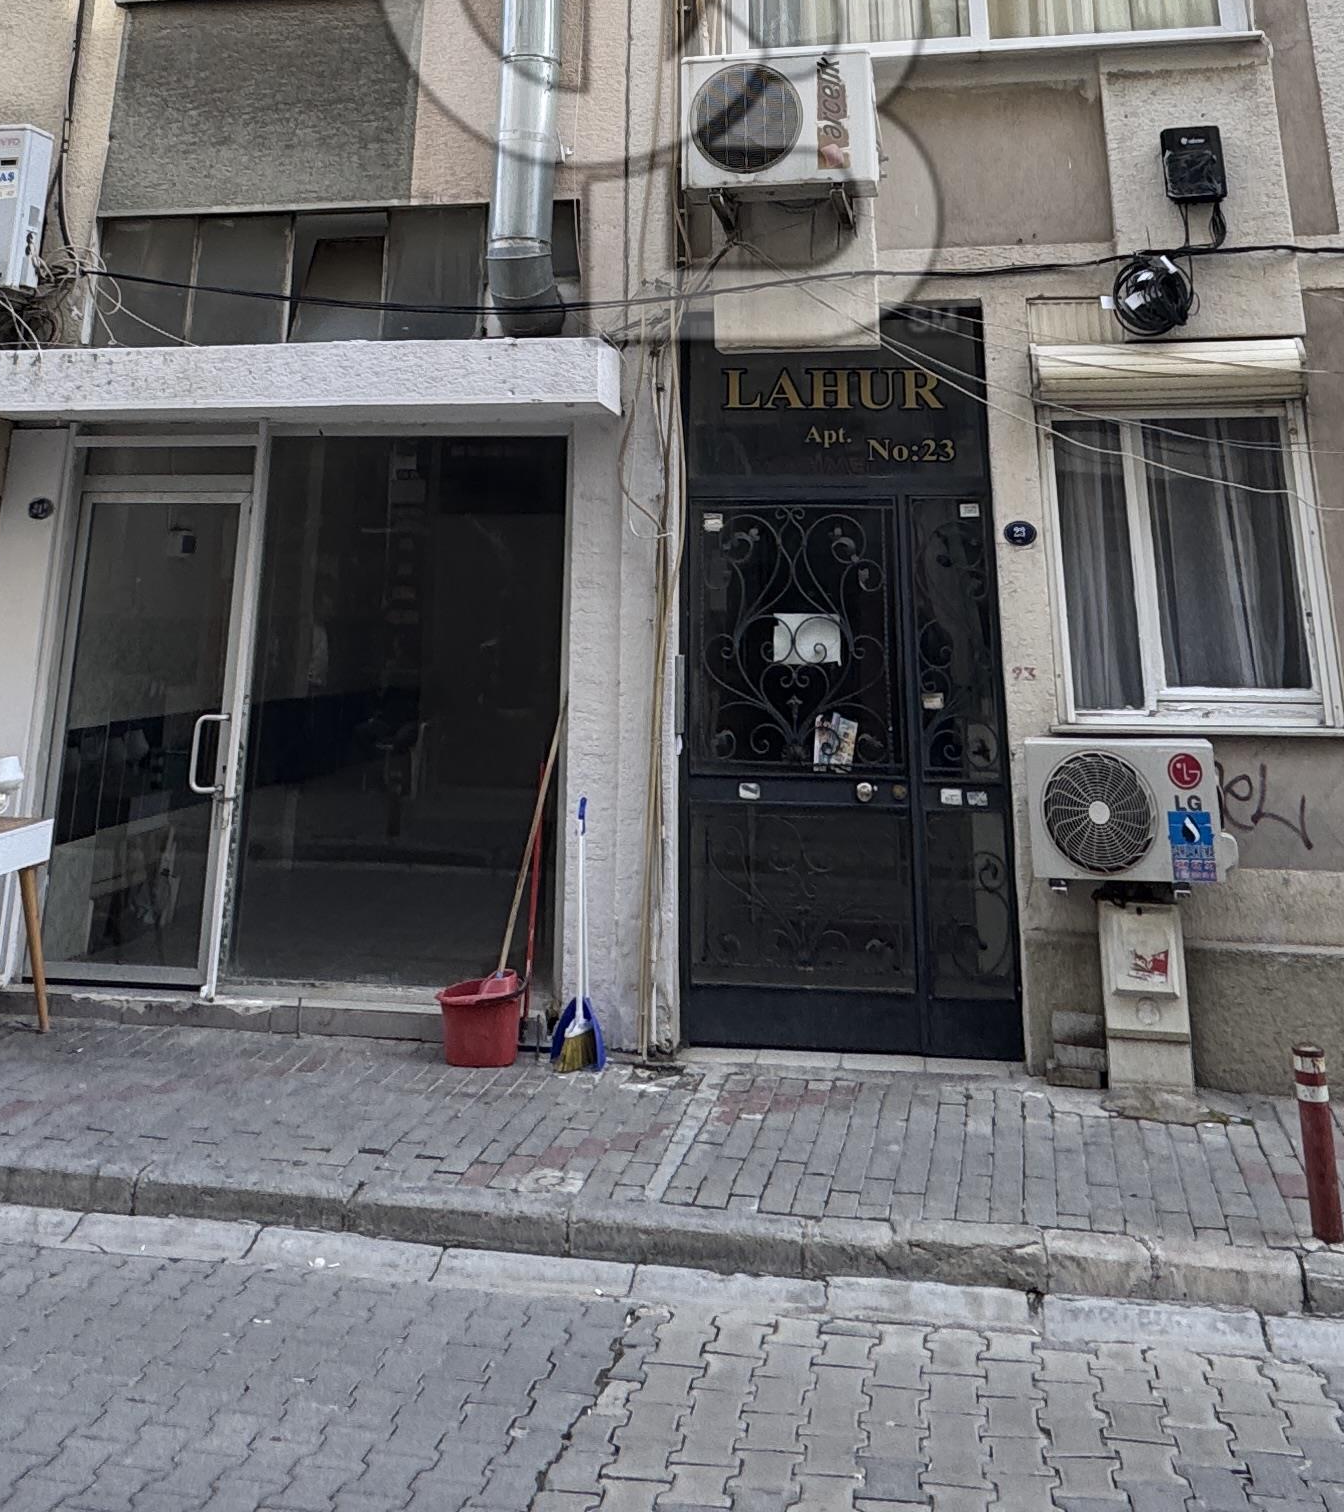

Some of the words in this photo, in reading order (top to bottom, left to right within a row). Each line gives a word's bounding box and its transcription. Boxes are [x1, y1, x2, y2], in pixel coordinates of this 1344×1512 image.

[722, 368, 945, 411] LAHUR
[805, 425, 853, 449] Apt.
[867, 438, 956, 463] No:23
[1174, 795, 1202, 811] LG
